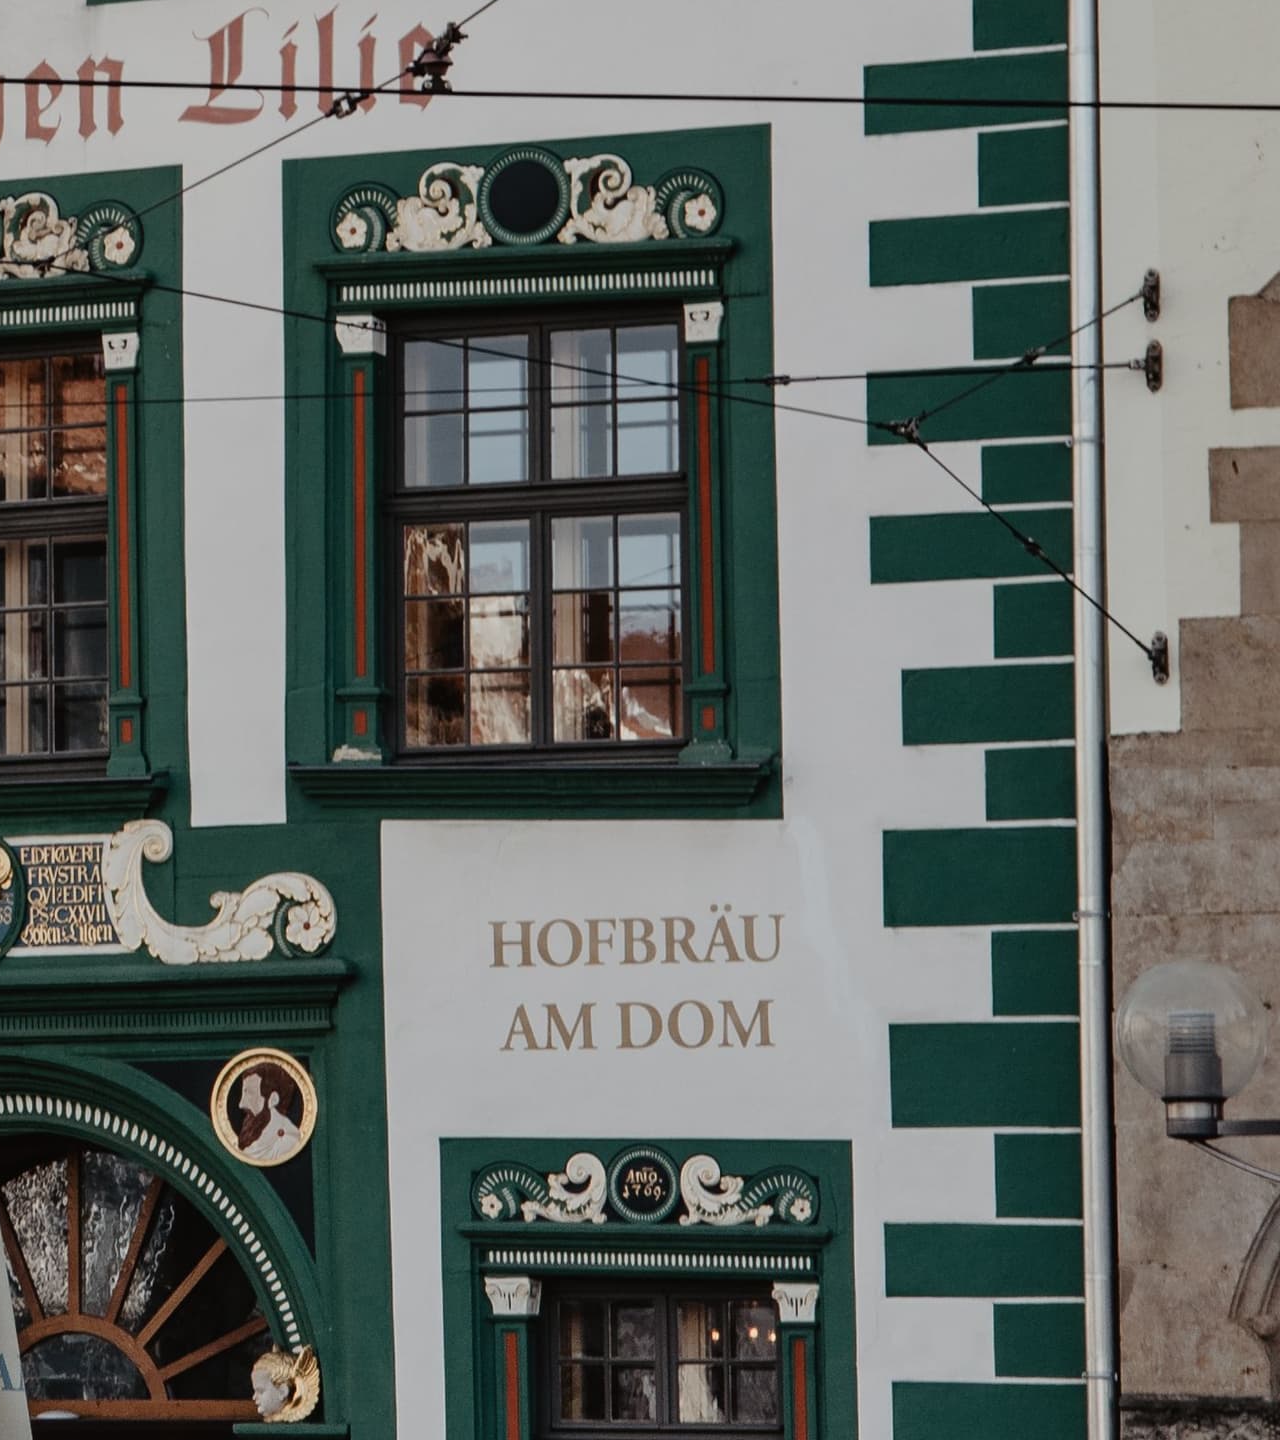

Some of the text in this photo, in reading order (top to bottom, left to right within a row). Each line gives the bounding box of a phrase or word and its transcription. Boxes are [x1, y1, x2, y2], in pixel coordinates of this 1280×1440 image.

[177, 3, 438, 126] Lilie
[488, 904, 786, 968] HOFBRÄU
[499, 999, 777, 1051] AM DOM
